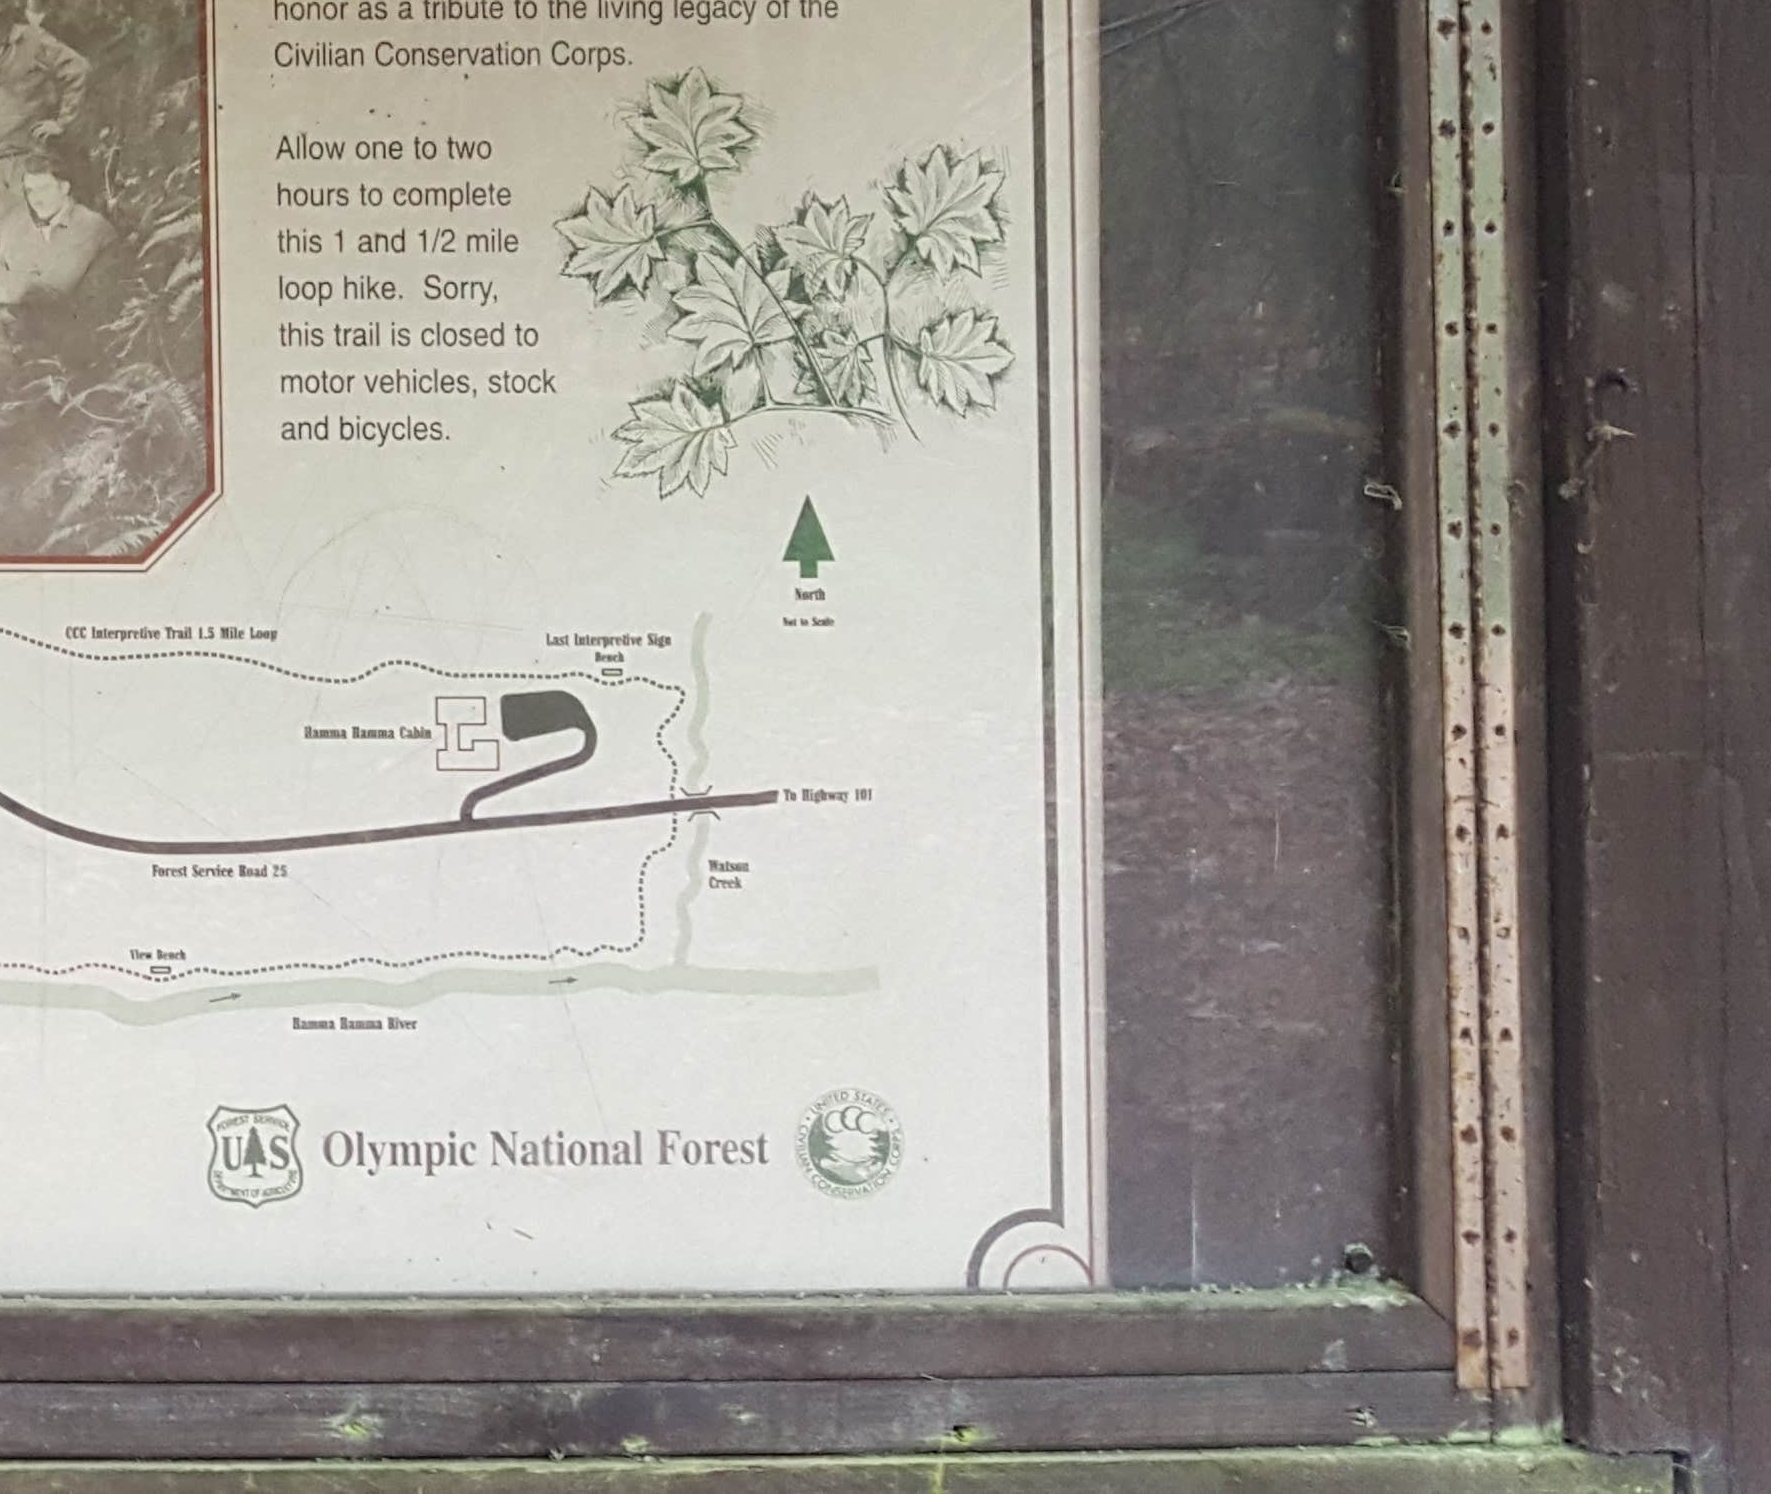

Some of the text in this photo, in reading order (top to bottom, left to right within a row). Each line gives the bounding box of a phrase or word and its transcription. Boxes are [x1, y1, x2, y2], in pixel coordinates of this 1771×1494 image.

[276, 226, 519, 254] this 1 and 1/2 mile
[278, 320, 539, 348] this trail is closed to
[279, 367, 557, 398] motor vehicles, stock
[794, 587, 826, 601] North
[64, 625, 278, 642] CCC Interpretive Trail 1.5 Mile Loop
[545, 632, 672, 649] Last Interpretive Sign
[594, 650, 625, 663] Bench
[303, 724, 432, 740] Hamma Hamma Cabin
[783, 787, 872, 804] To Highway 101
[151, 863, 287, 878] Forest Service Road 25
[707, 859, 750, 873] Watson
[708, 875, 743, 889] Creek
[129, 948, 186, 961] View Bench
[292, 1016, 418, 1030] Hamma Hamma River
[322, 1128, 770, 1177] Olympic National Forest
